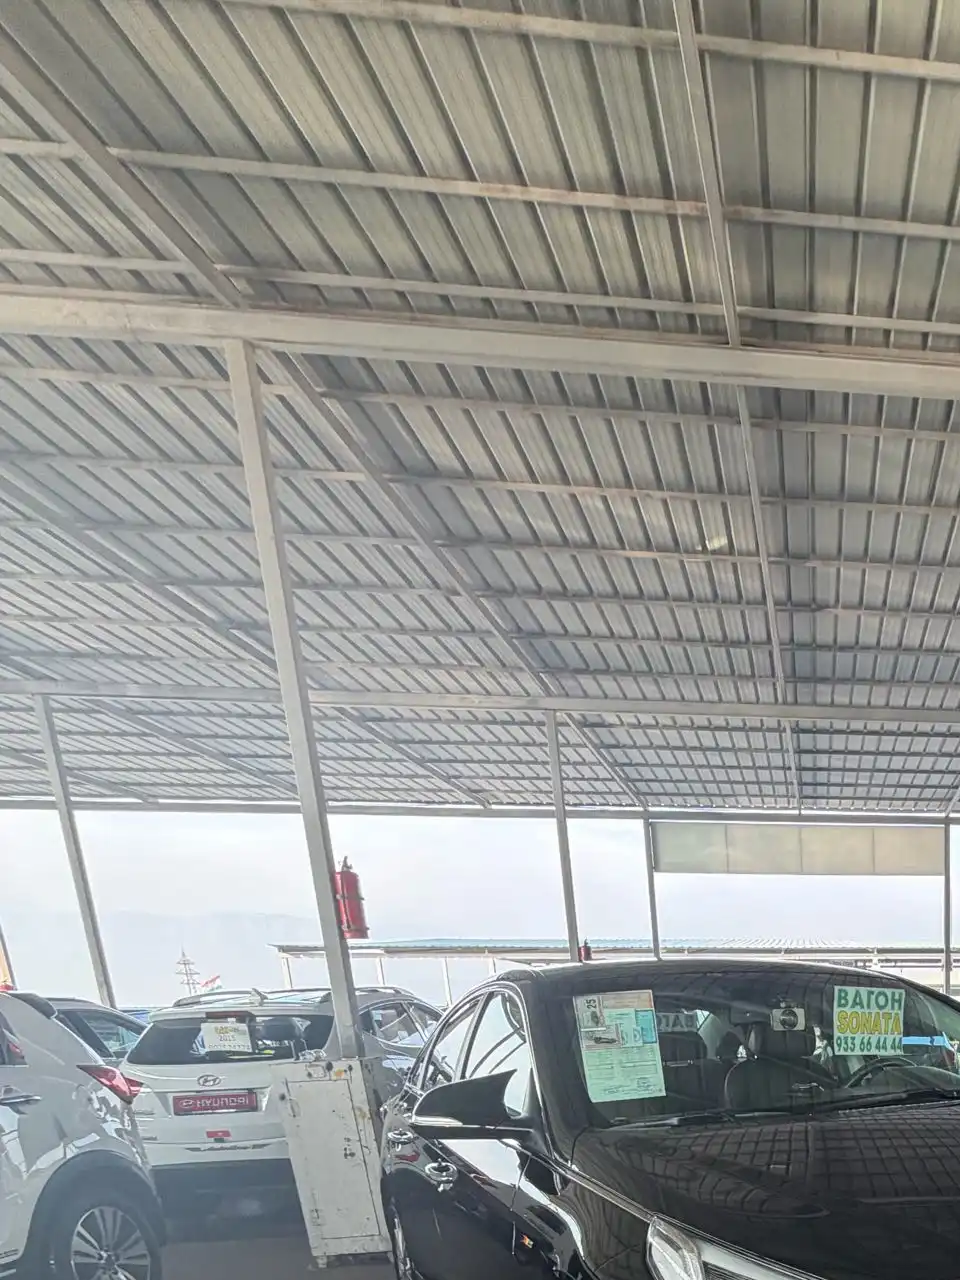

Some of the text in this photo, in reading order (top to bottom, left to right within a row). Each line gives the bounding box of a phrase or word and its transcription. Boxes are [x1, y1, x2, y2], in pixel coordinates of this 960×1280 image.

[837, 989, 903, 1010] ВАГОН
[837, 1010, 902, 1035] SONATA
[836, 1036, 902, 1053] 933 66 44 44
[196, 1096, 249, 1108] HYUNDAI
